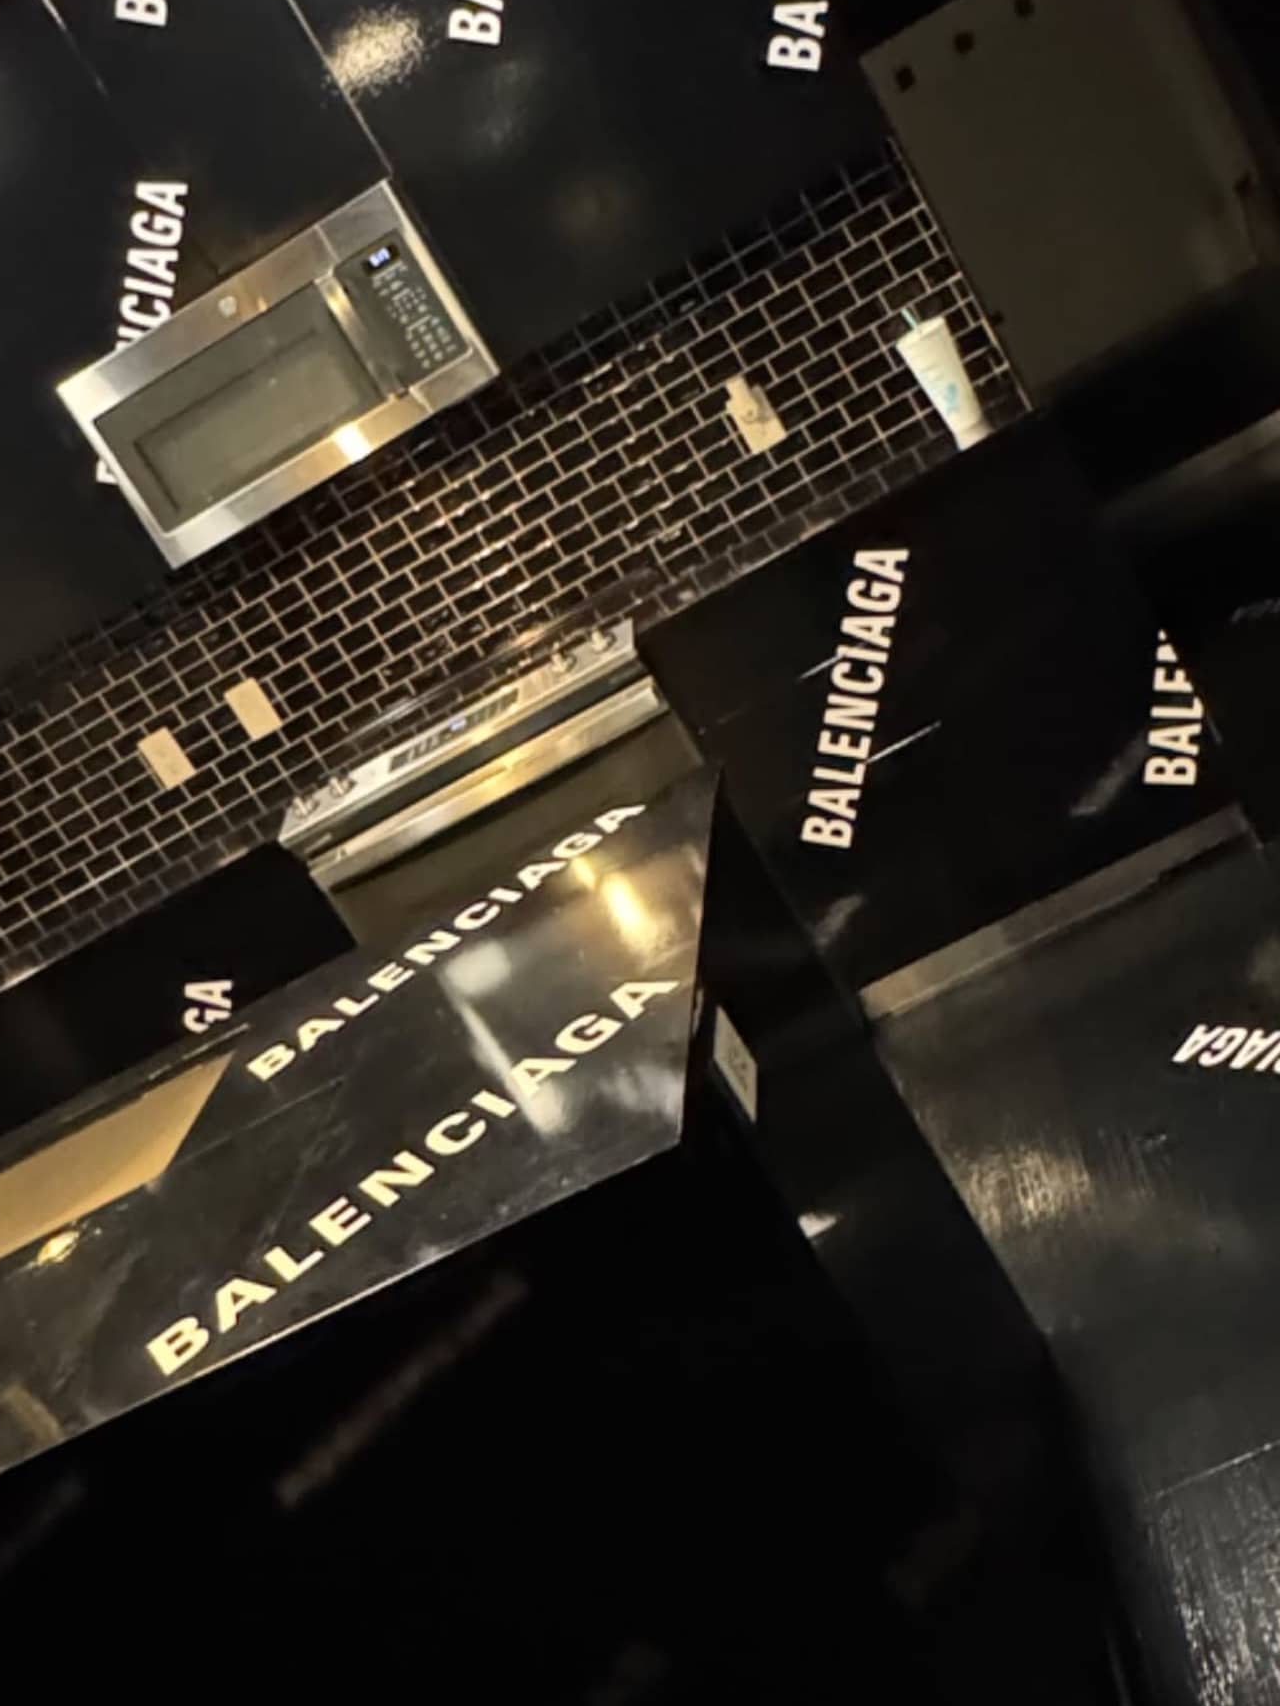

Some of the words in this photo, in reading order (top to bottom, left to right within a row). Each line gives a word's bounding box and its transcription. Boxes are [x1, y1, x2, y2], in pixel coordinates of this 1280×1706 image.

[799, 547, 911, 850] BALENCIAGA
[246, 801, 647, 1083] BALENCIAGA
[145, 977, 681, 1377] BALENCIAGA
